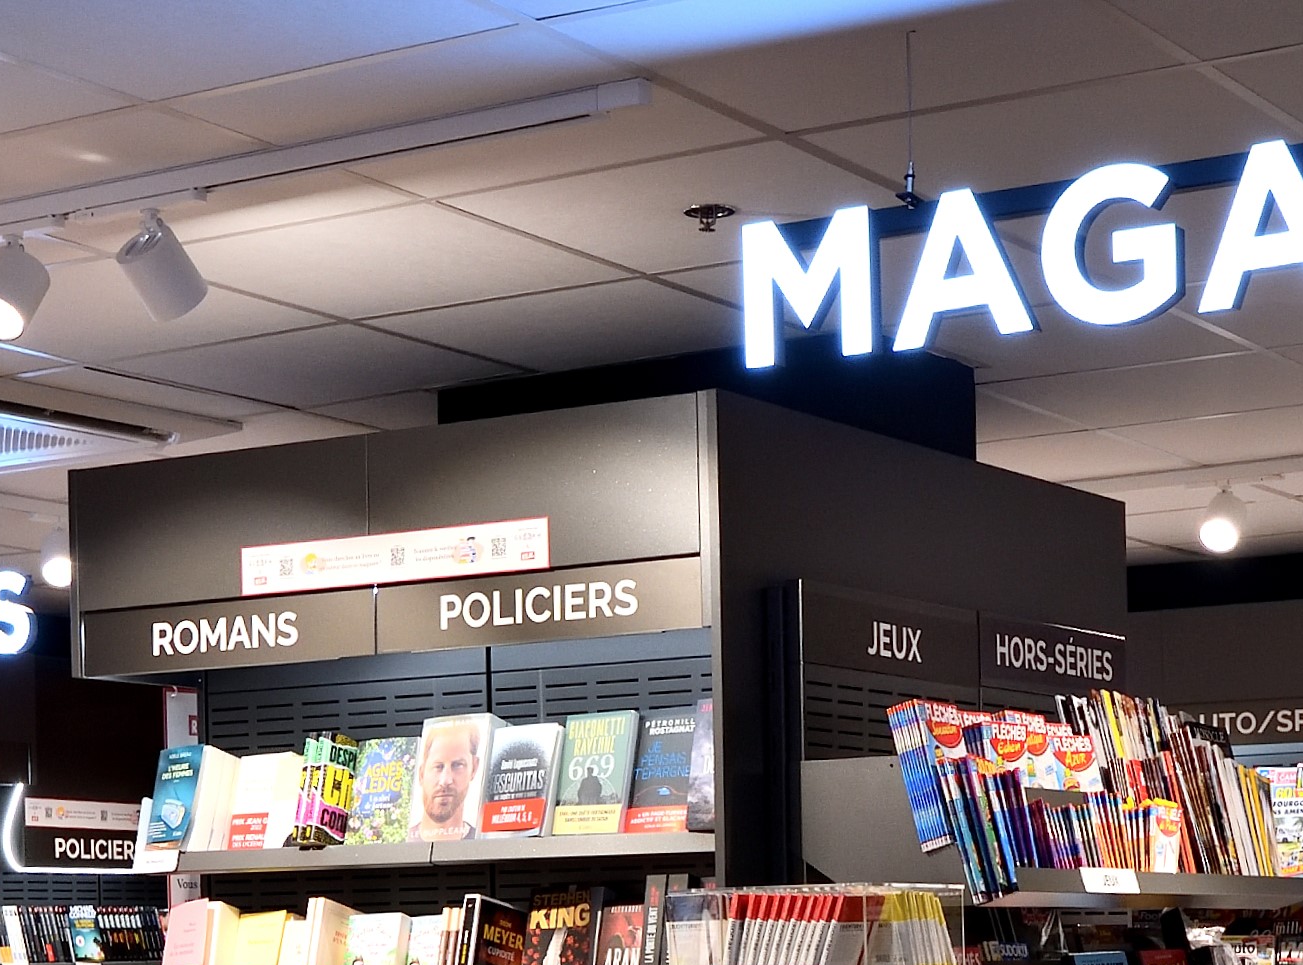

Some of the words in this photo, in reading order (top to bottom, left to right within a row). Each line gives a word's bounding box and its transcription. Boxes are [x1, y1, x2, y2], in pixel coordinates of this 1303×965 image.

[439, 579, 639, 630] POLICIERS
[152, 611, 300, 656] ROMANS
[867, 620, 923, 663] JEUX
[996, 633, 1114, 681] HORS-SÉRIES
[568, 754, 615, 780] 669
[54, 837, 135, 860] POLICIER
[529, 903, 591, 930] KING
[483, 924, 524, 950] MEYER
